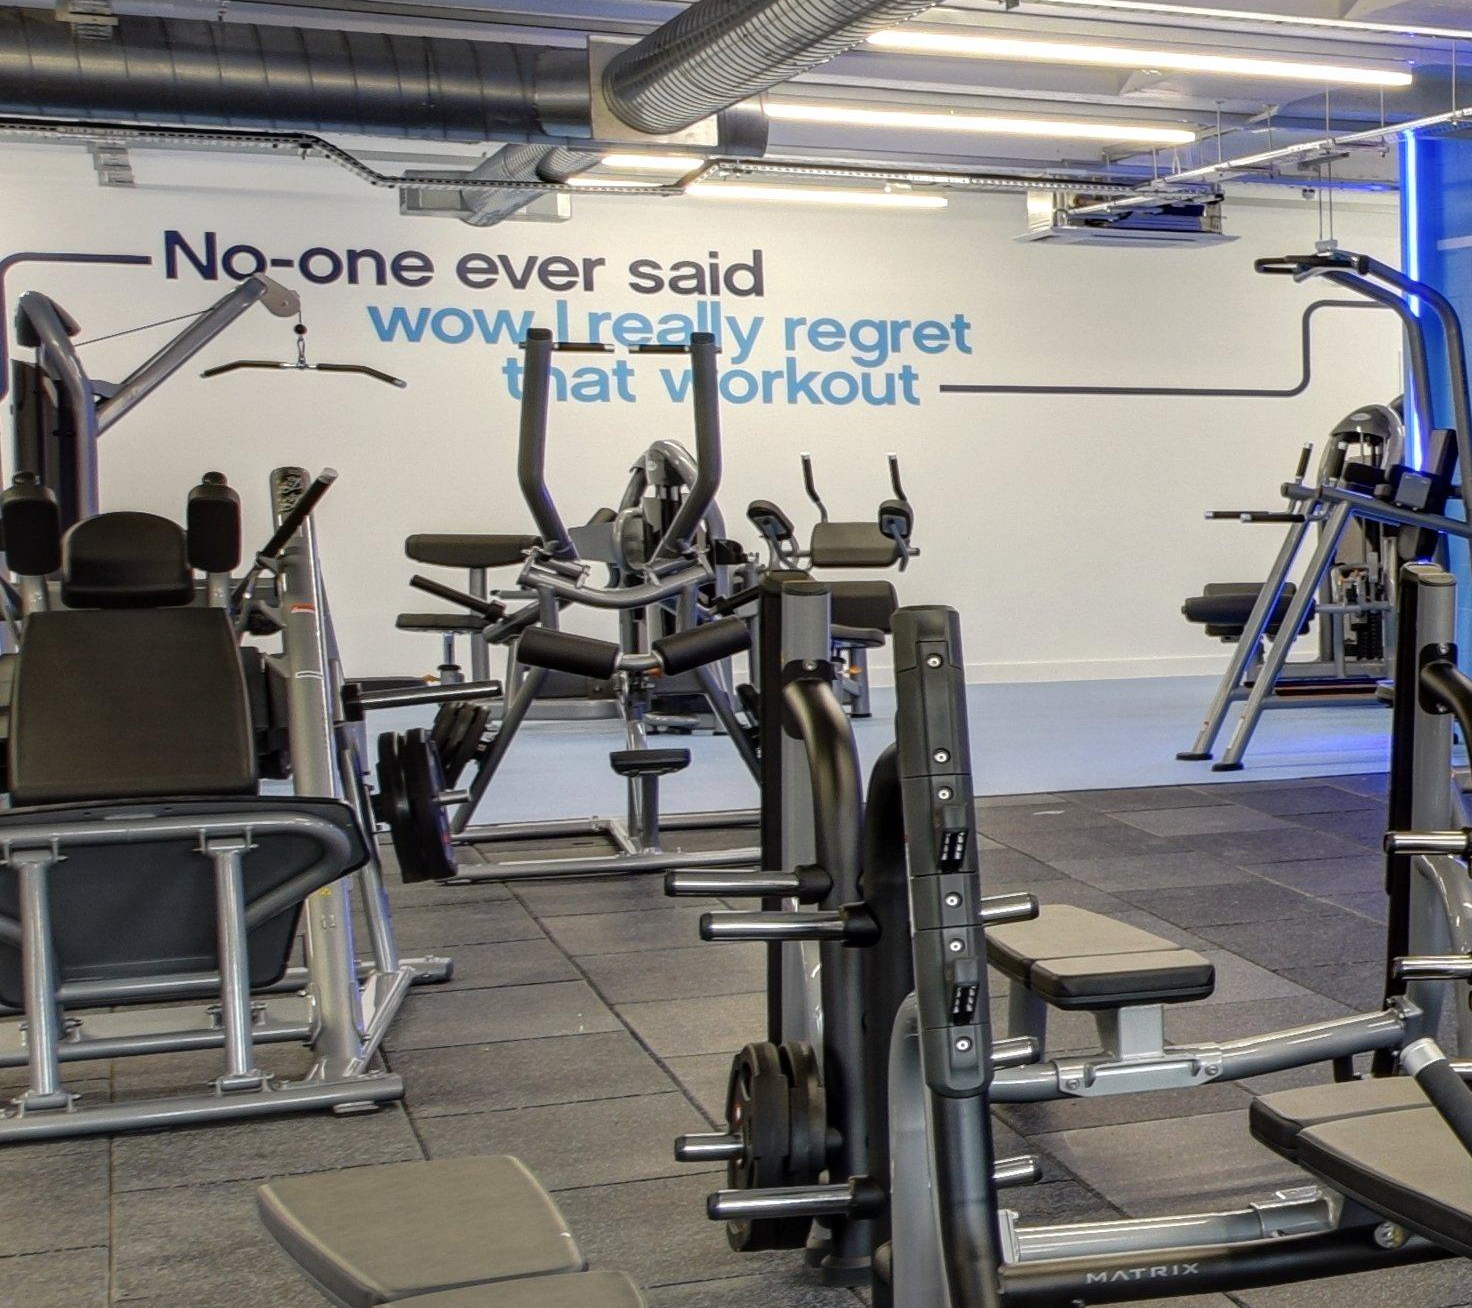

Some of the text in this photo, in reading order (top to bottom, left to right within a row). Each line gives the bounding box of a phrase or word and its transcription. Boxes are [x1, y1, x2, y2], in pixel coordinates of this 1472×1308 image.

[164, 228, 765, 298] No-one ever said
[556, 299, 568, 343] I
[588, 299, 764, 364] really
[784, 313, 972, 368] regret
[659, 356, 920, 406] workout
[1086, 1263, 1199, 1285] MATRIX
